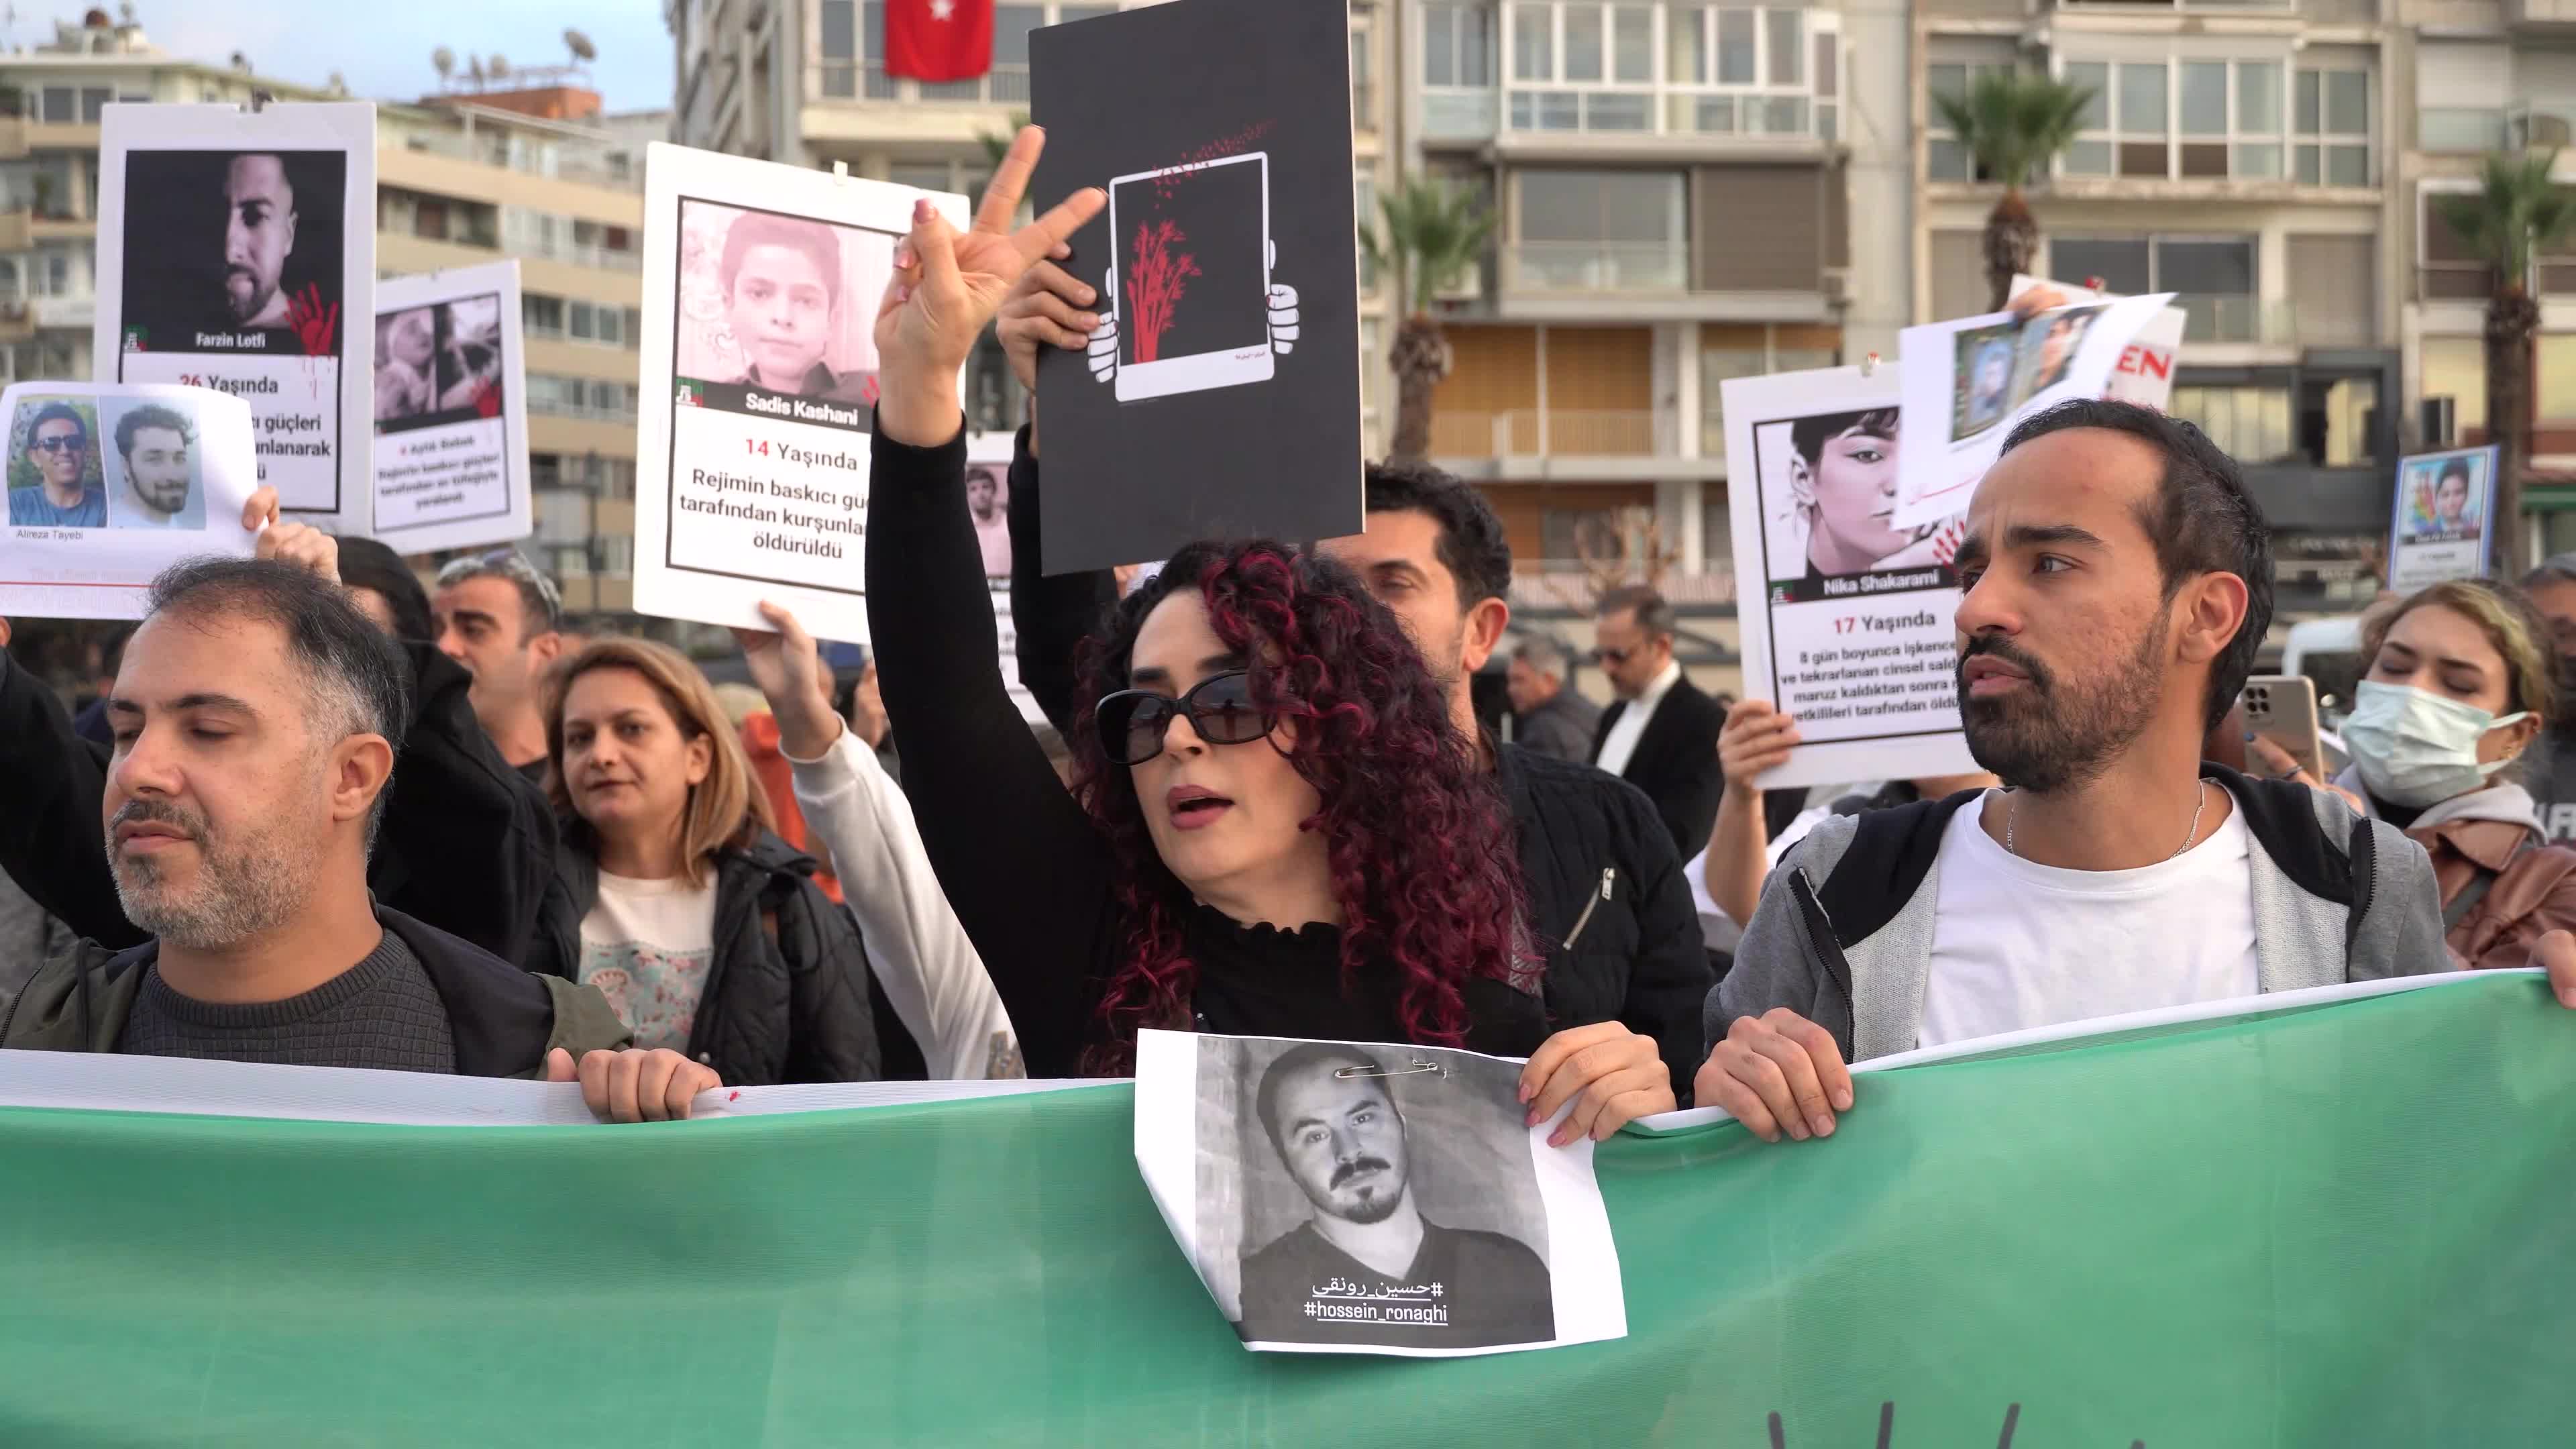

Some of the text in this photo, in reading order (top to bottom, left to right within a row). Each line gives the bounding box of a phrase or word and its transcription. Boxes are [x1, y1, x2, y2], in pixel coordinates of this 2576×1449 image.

[195, 333, 266, 347] Farzin Lotfi
[208, 375, 279, 396] Yaşında
[745, 392, 859, 426] Sadis Kashani
[264, 414, 321, 434] güçleri
[745, 439, 857, 471] 14 Yaşında
[692, 469, 765, 494] Rejimin
[770, 479, 837, 505] baskıcı
[680, 494, 777, 523] tarafından
[753, 531, 843, 559] öldürüldü
[1823, 570, 1940, 596] Nika Shakarami
[1835, 610, 1936, 633] 17 Yaşında
[1812, 651, 1838, 665] gün
[1841, 646, 1900, 663] boyunca
[1781, 674, 1796, 685] ve
[1882, 660, 1924, 676] cinsel
[1793, 691, 1837, 703] maruz
[1841, 683, 1905, 699] kaldıktan
[1909, 680, 1948, 692] sonra
[1856, 699, 1927, 716] tarafından
[1303, 1300, 1448, 1324] #hossein_ronaghi
